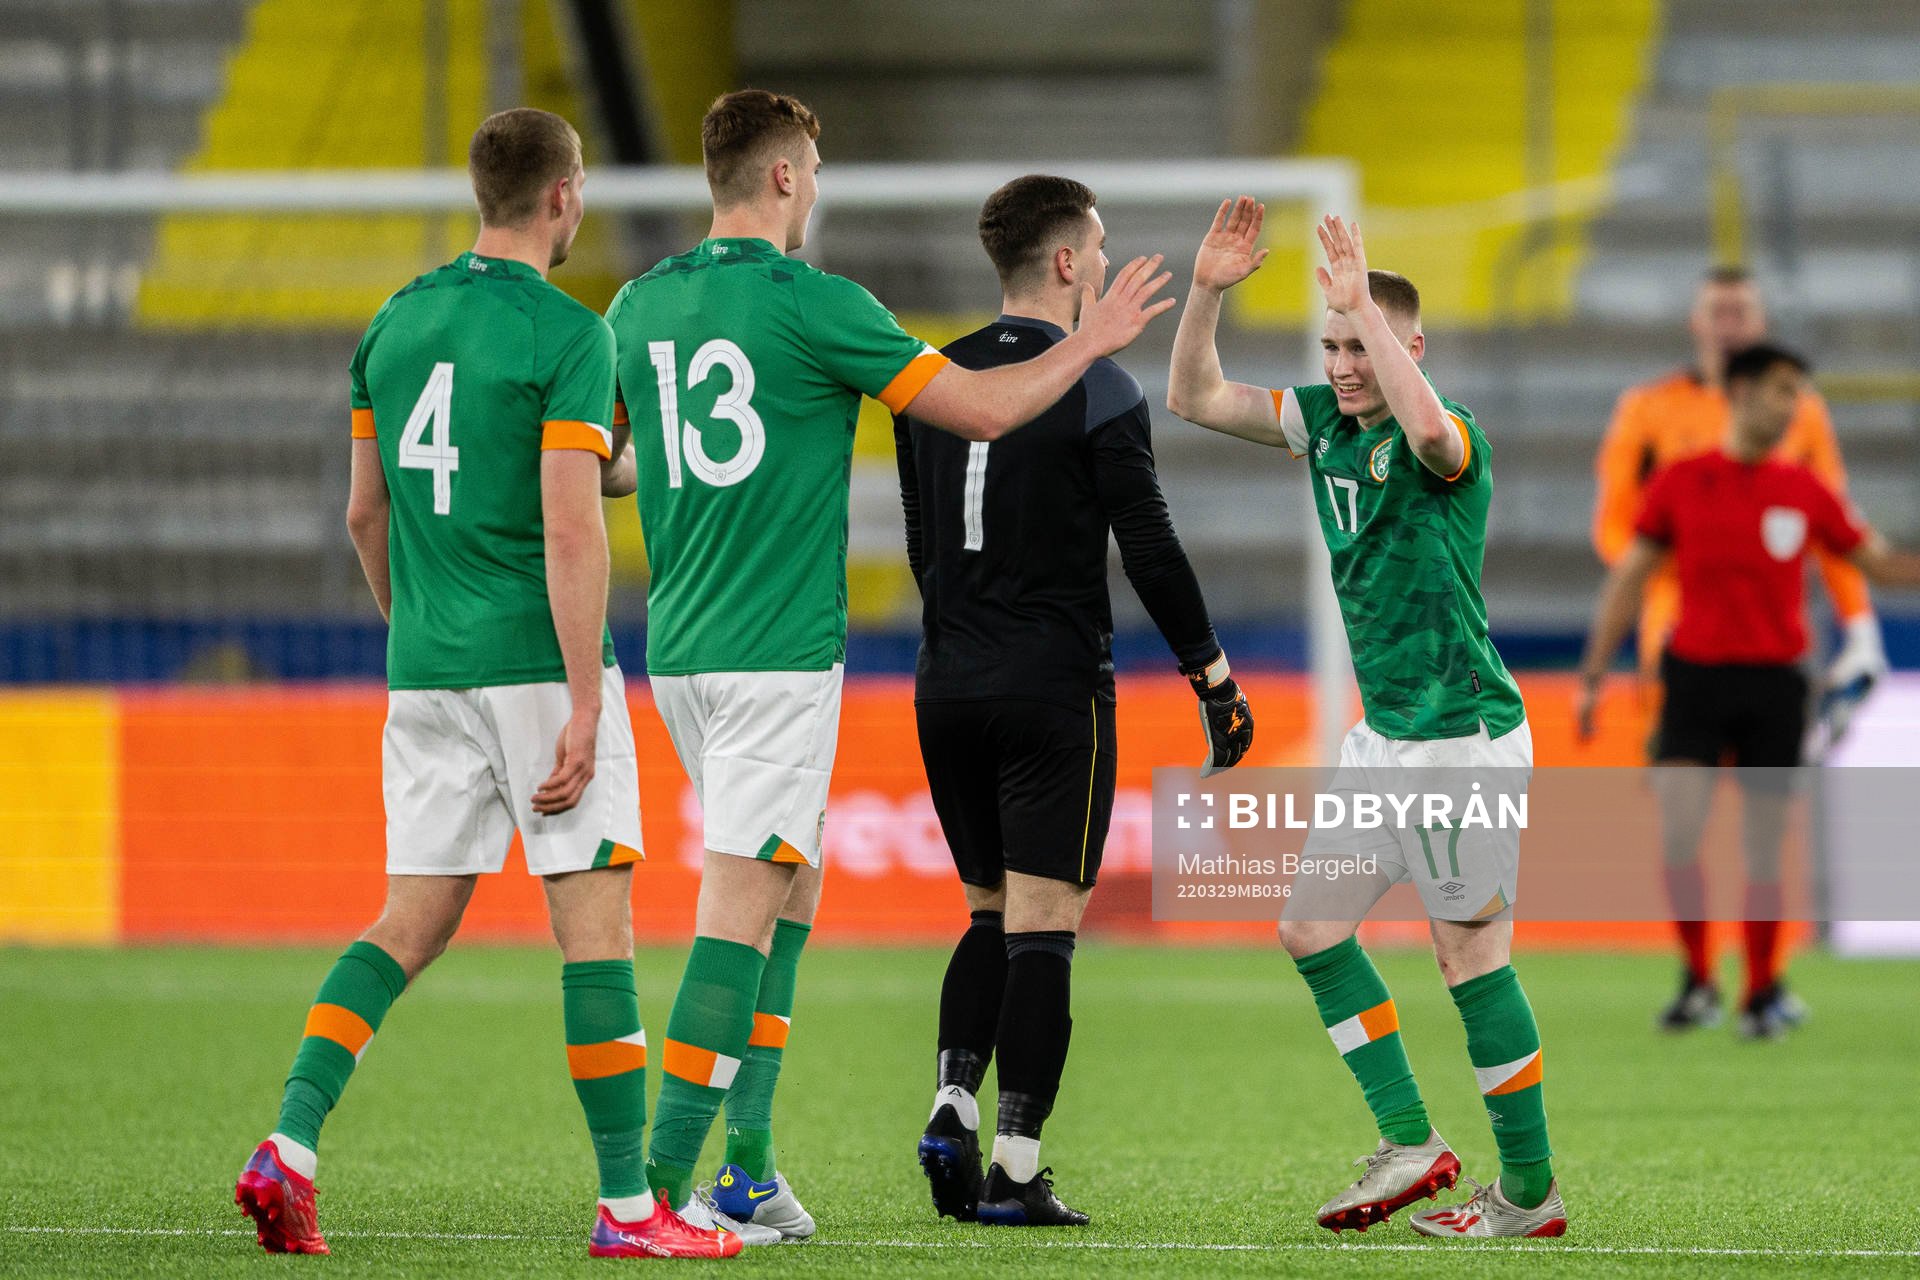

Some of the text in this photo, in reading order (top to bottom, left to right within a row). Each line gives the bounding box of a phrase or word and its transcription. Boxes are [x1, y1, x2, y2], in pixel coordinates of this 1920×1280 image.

[399, 362, 458, 515] 4
[648, 338, 766, 488] 13
[964, 441, 989, 551] 1
[1325, 475, 1359, 533] 17
[1414, 818, 1463, 879] 17
